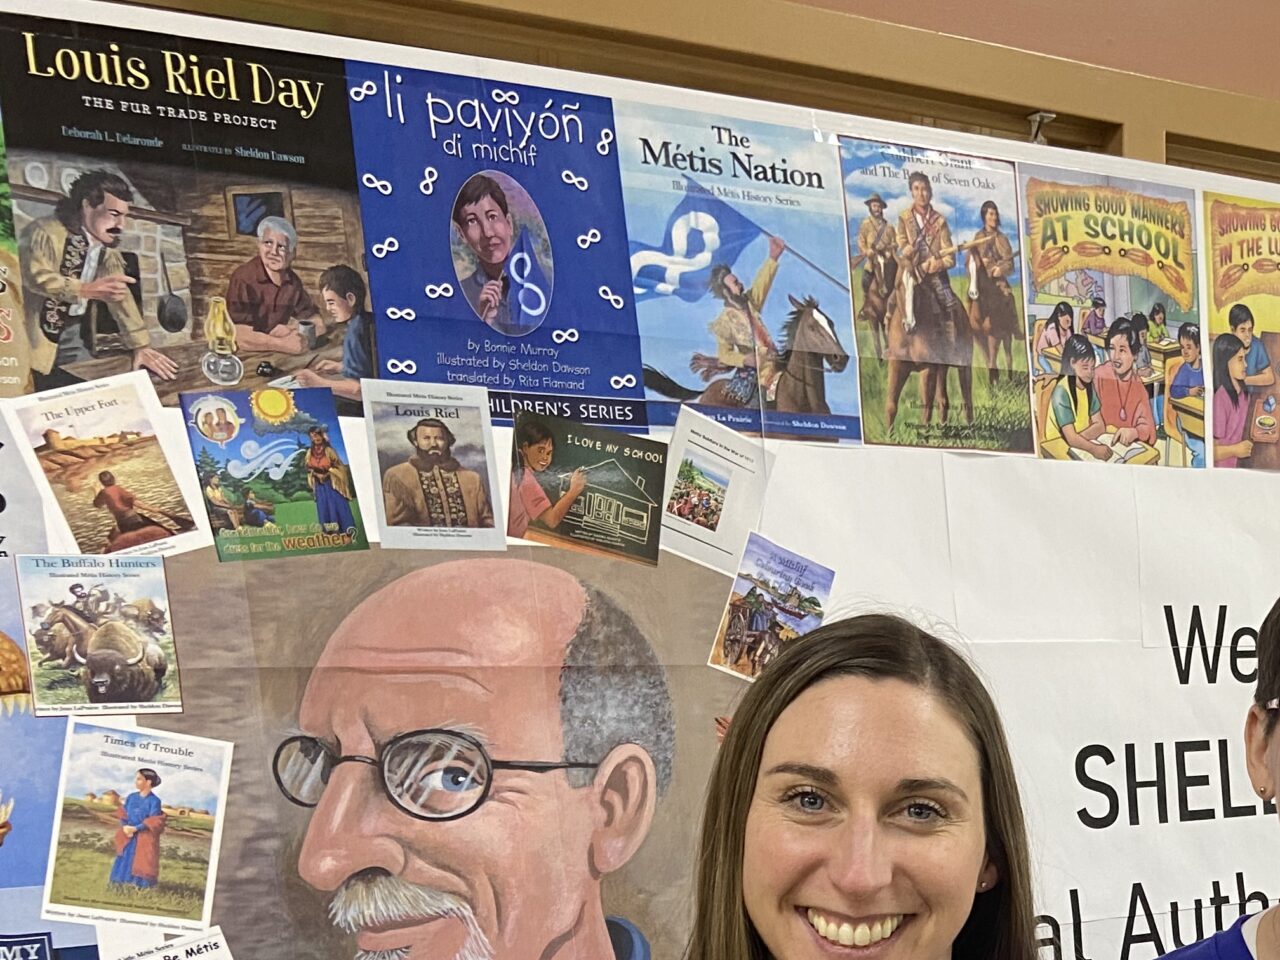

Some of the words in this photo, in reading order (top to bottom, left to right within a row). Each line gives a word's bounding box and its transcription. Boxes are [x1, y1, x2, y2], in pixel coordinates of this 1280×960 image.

[21, 32, 150, 90] Louis
[161, 50, 240, 101] Riel
[246, 62, 324, 118] Day
[81, 95, 115, 111] THE
[120, 100, 151, 115] FUR
[156, 105, 208, 122] TRADE
[214, 112, 277, 130] PROJECT
[384, 70, 405, 124] li
[443, 133, 463, 158] di
[472, 137, 537, 167] michif
[711, 125, 750, 148] The
[638, 137, 723, 176] Métis
[730, 151, 825, 189] Nation
[1094, 192, 1127, 216] GOOD
[1131, 198, 1185, 239] MANNERS
[1041, 215, 1072, 250] AT
[1083, 213, 1185, 270] SCHOOL
[1220, 243, 1233, 267] IN
[1237, 237, 1263, 259] THE
[467, 338, 481, 353] by
[484, 339, 517, 353] Bonnie
[520, 343, 559, 359] Murray
[492, 356, 505, 371] by
[509, 359, 549, 371] Sheldon
[552, 361, 591, 375] Dawson
[41, 409, 64, 422] The
[66, 402, 97, 419] Upper
[97, 397, 119, 411] Fort
[394, 404, 431, 418] Louis
[434, 405, 460, 420] Riel
[32, 558, 58, 569] The
[61, 558, 105, 569] Buffalo
[108, 558, 157, 569] Hunters
[1164, 605, 1258, 686] We
[104, 735, 136, 748] Times
[139, 741, 151, 750] of
[153, 743, 194, 757] Trouble
[1074, 739, 1276, 829] SHEL
[185, 940, 220, 960] Métis
